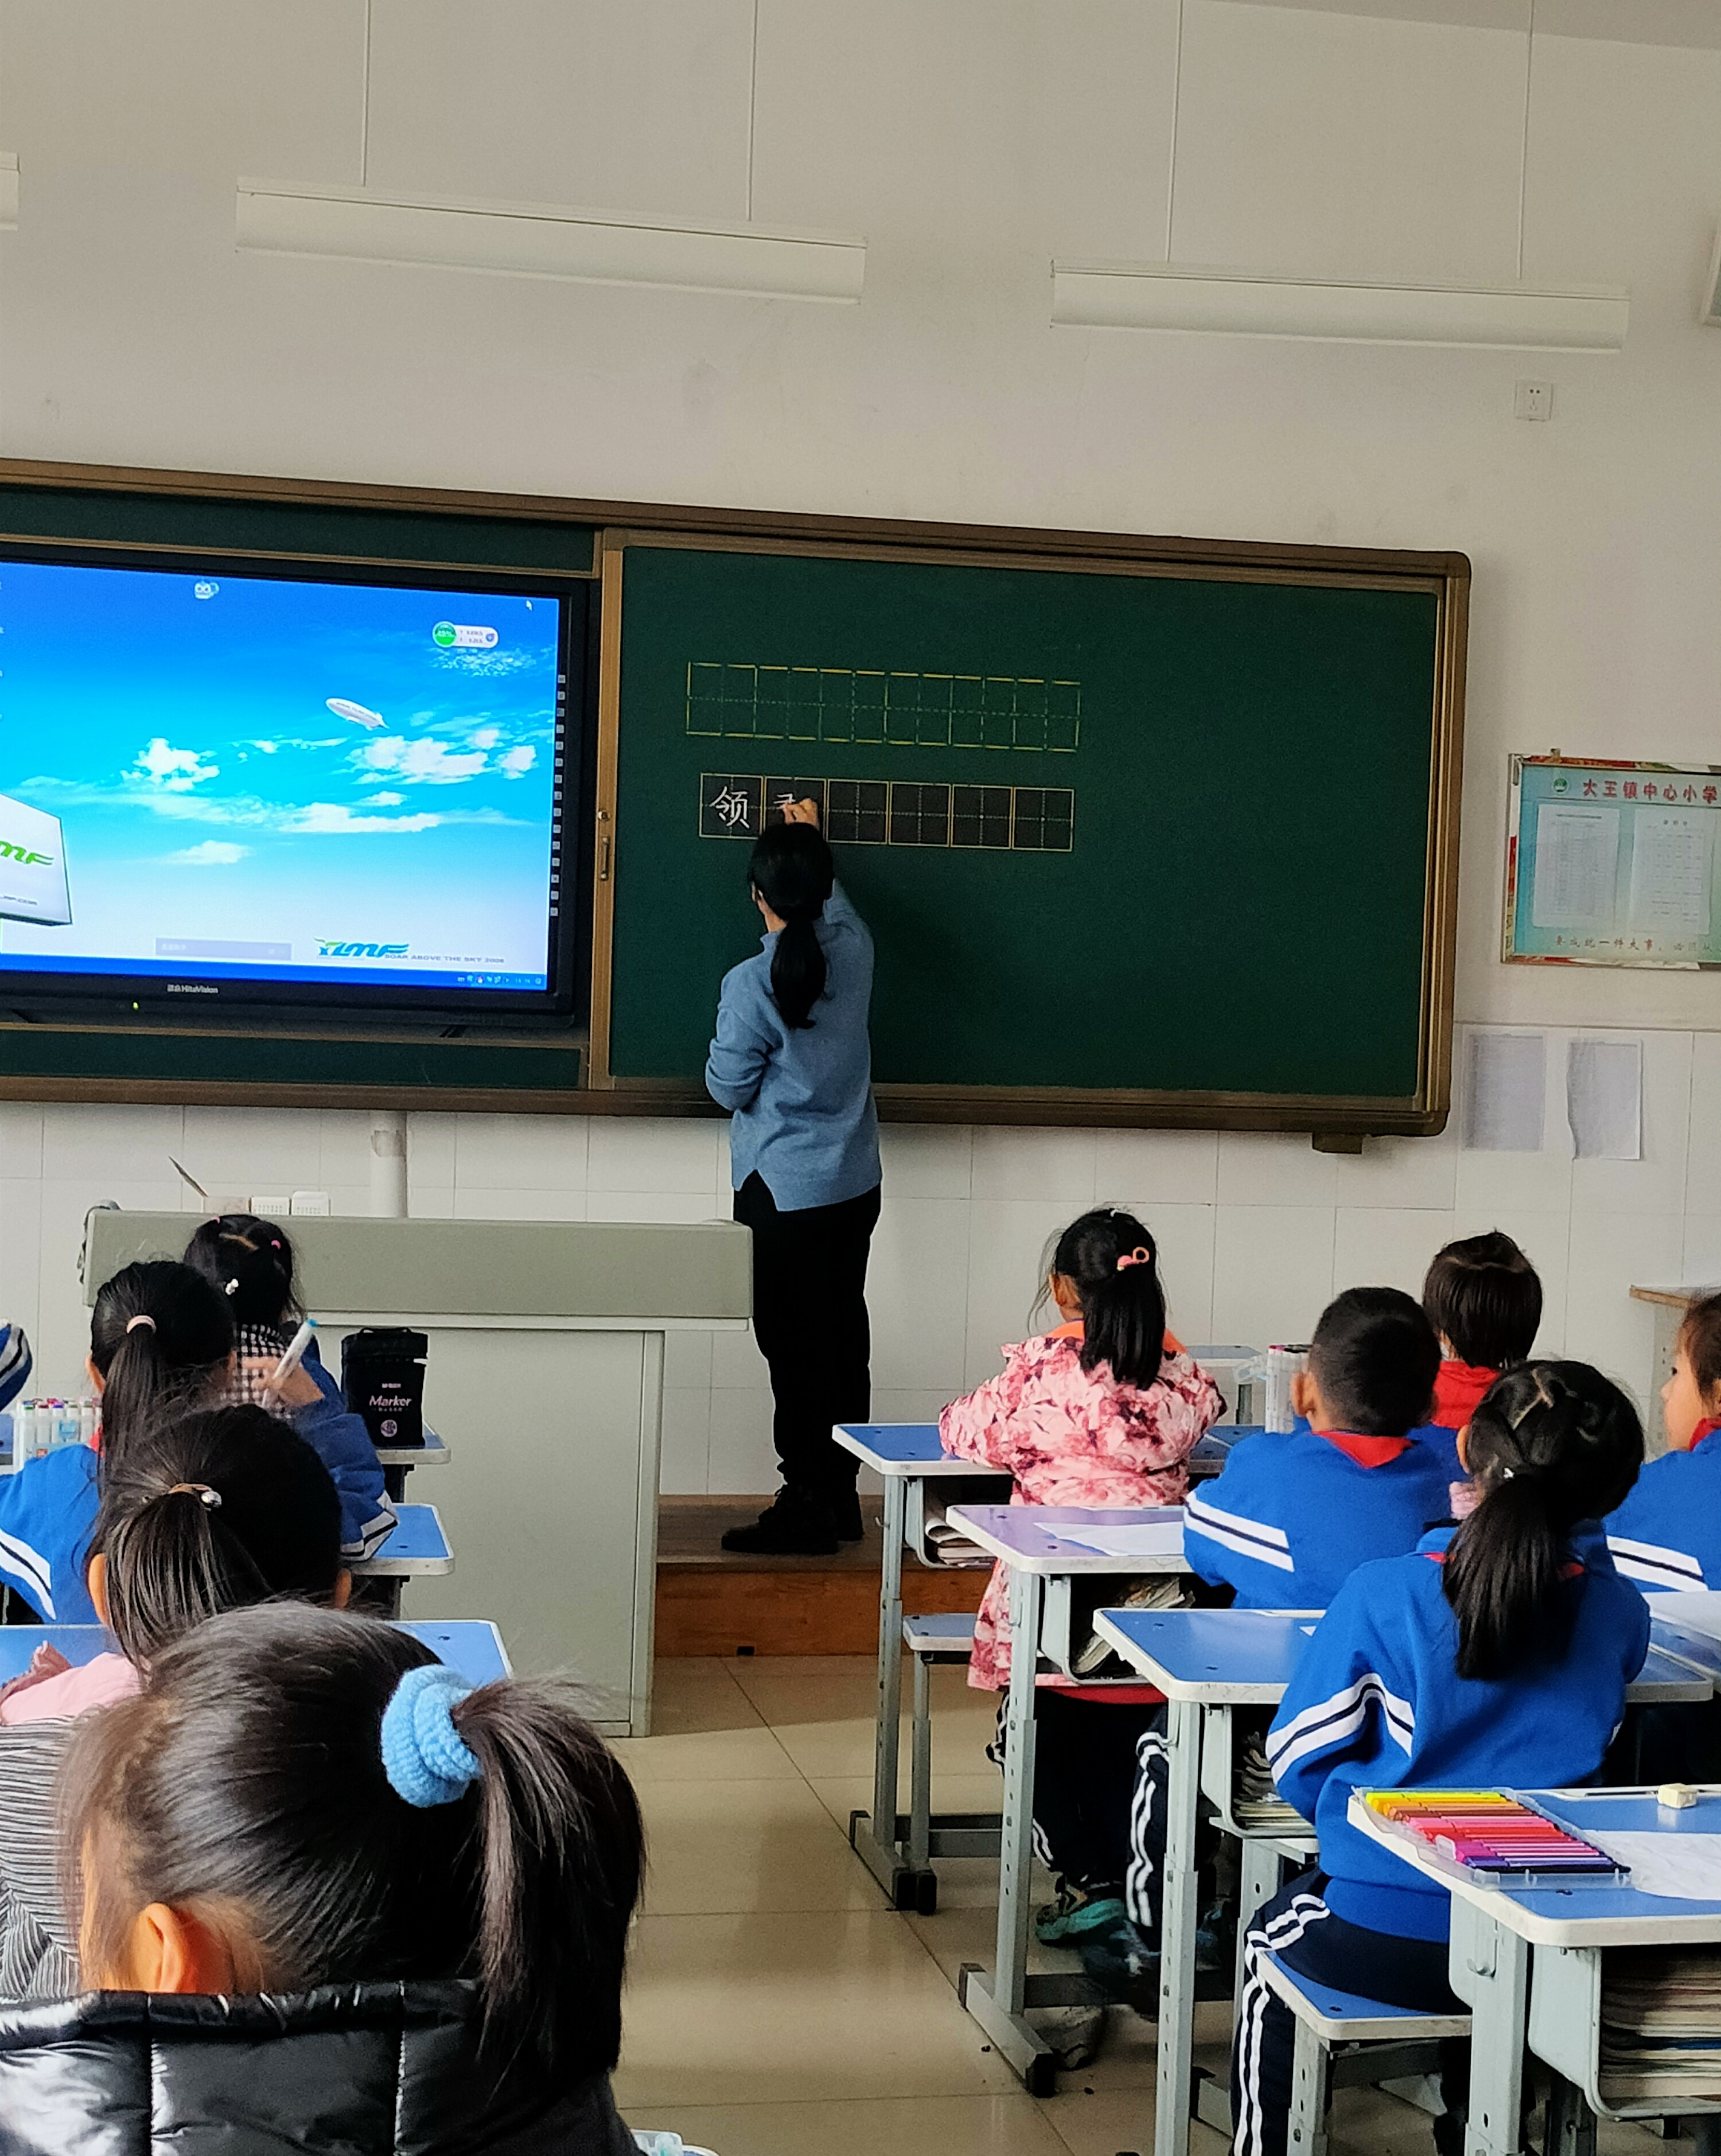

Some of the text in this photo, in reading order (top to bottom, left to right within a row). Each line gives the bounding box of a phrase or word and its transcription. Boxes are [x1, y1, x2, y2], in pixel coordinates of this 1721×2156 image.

[1583, 779, 1718, 804] 大王镇中心小学
[369, 1395, 412, 1407] Marker
